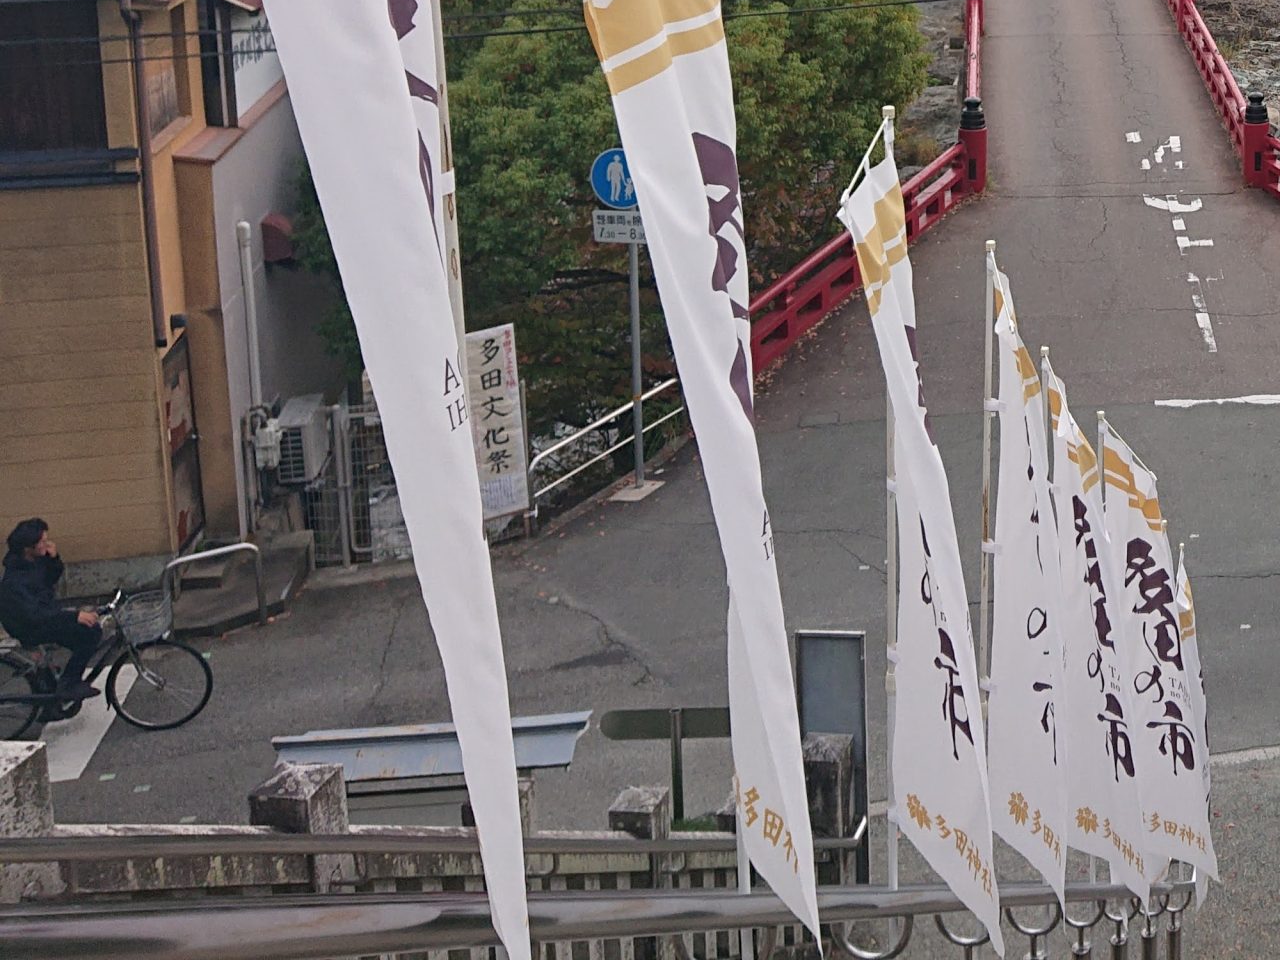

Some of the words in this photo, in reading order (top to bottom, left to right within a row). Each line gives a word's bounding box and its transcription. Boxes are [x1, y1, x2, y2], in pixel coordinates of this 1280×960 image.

[481, 338, 513, 474] 多田文化祭
[935, 814, 994, 902] 多田神社
[1103, 817, 1145, 879] 多田神社
[1149, 810, 1208, 855] 多田神社
